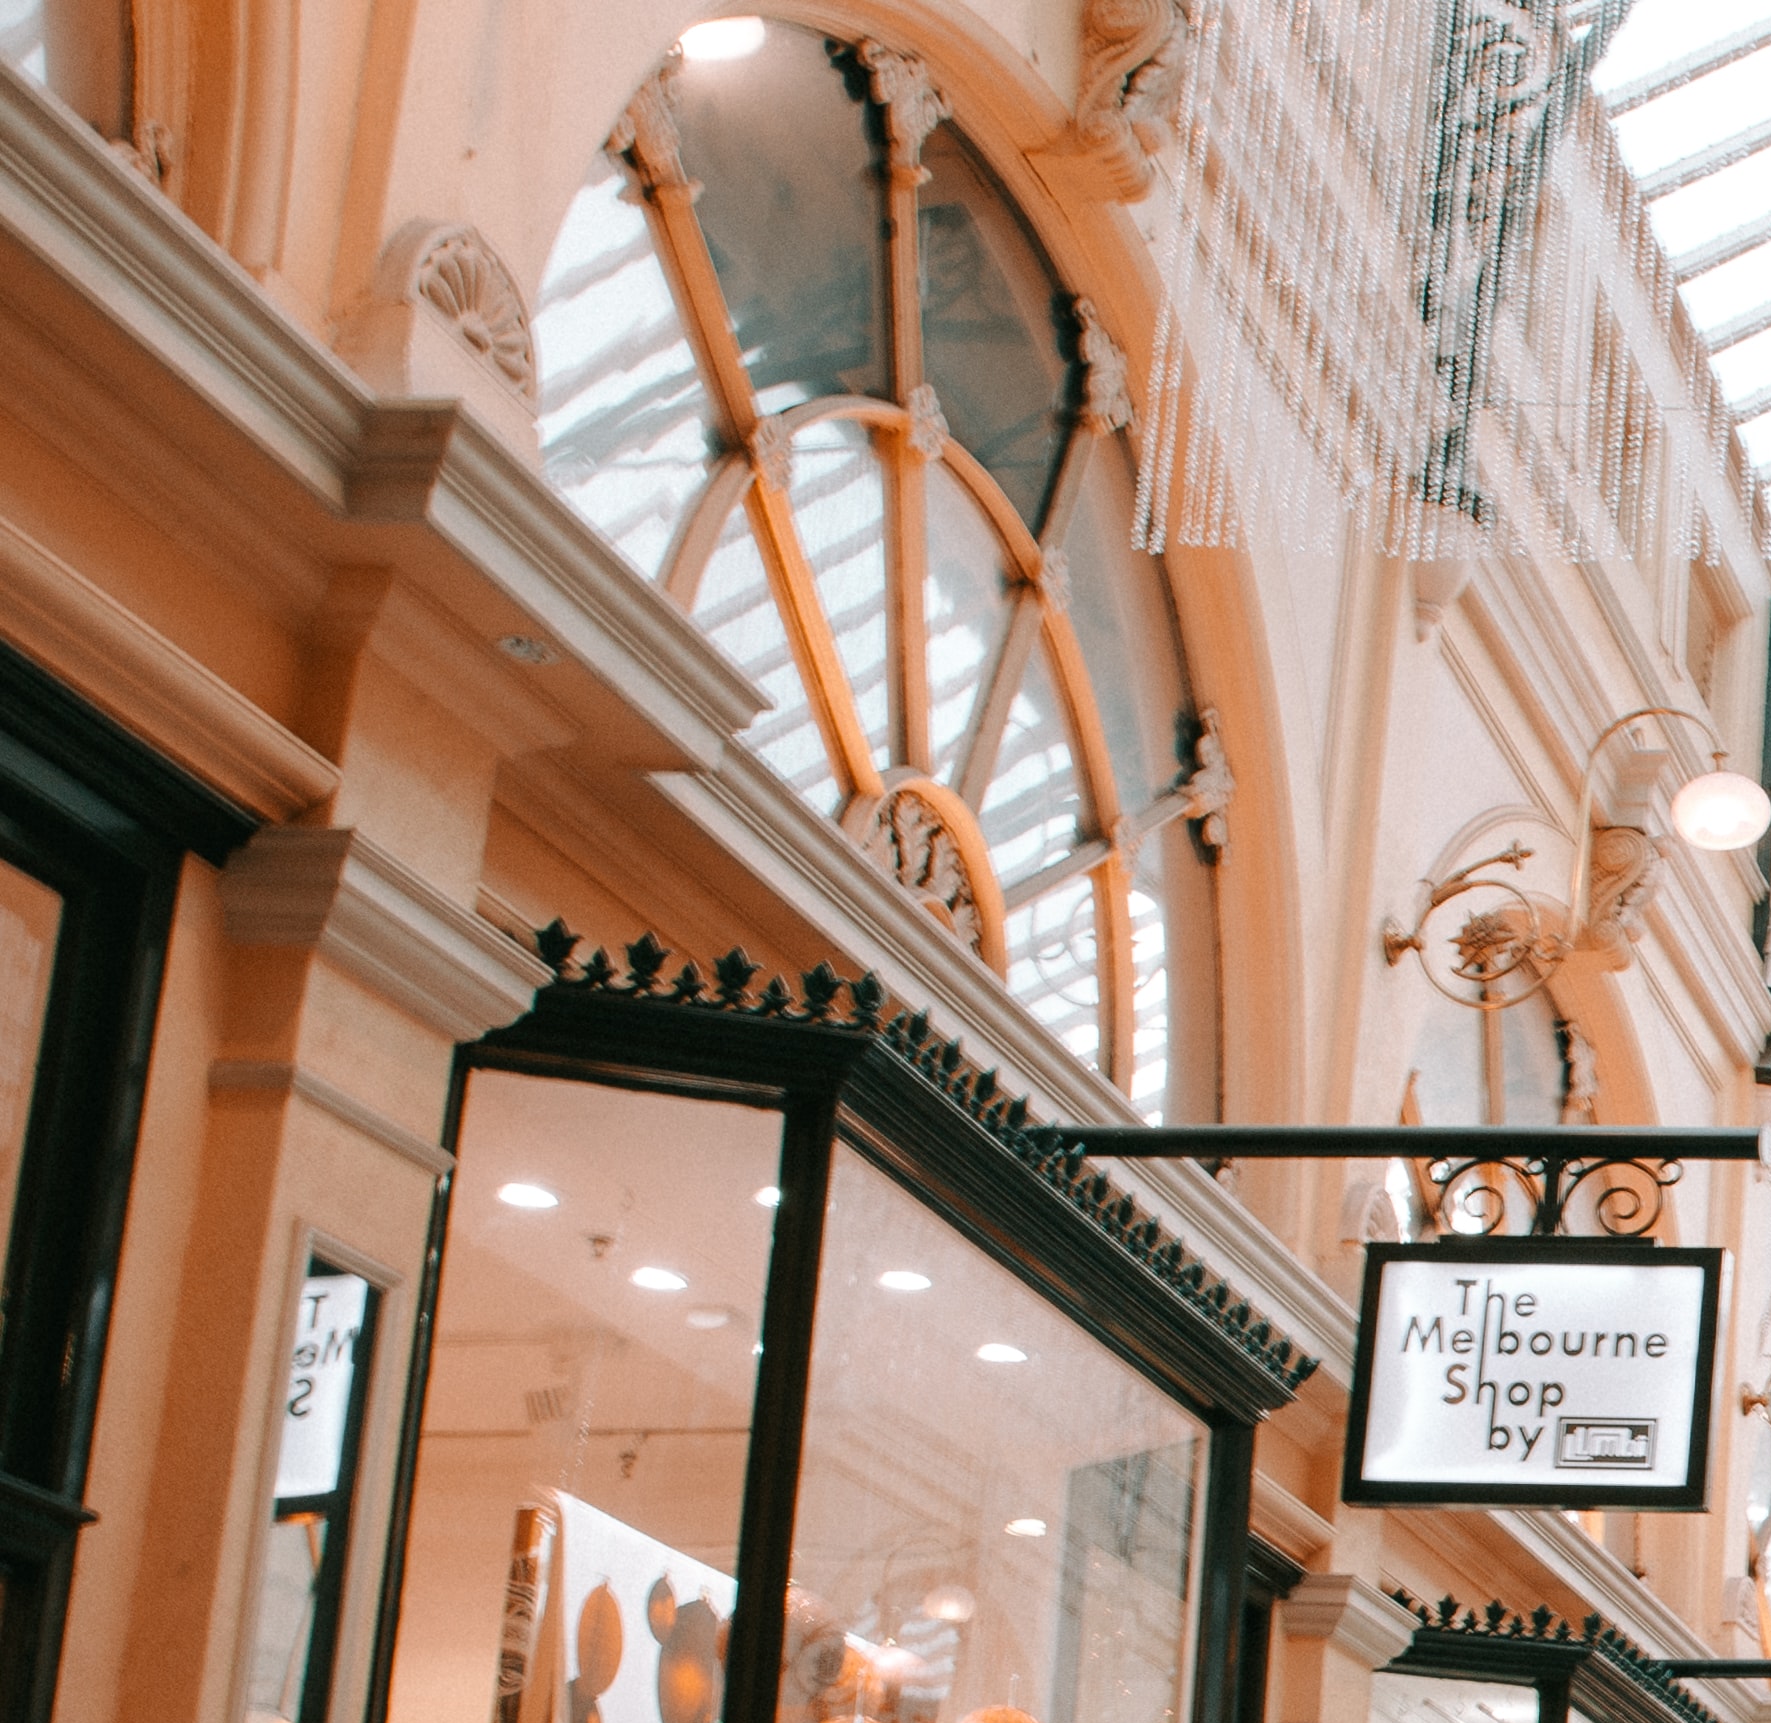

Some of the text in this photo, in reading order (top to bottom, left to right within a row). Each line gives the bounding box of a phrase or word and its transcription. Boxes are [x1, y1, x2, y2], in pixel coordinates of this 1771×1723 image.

[1455, 1279, 1537, 1318] The
[1402, 1316, 1669, 1360] Melbourne
[1443, 1363, 1565, 1416] Shop
[1488, 1422, 1544, 1461] by
